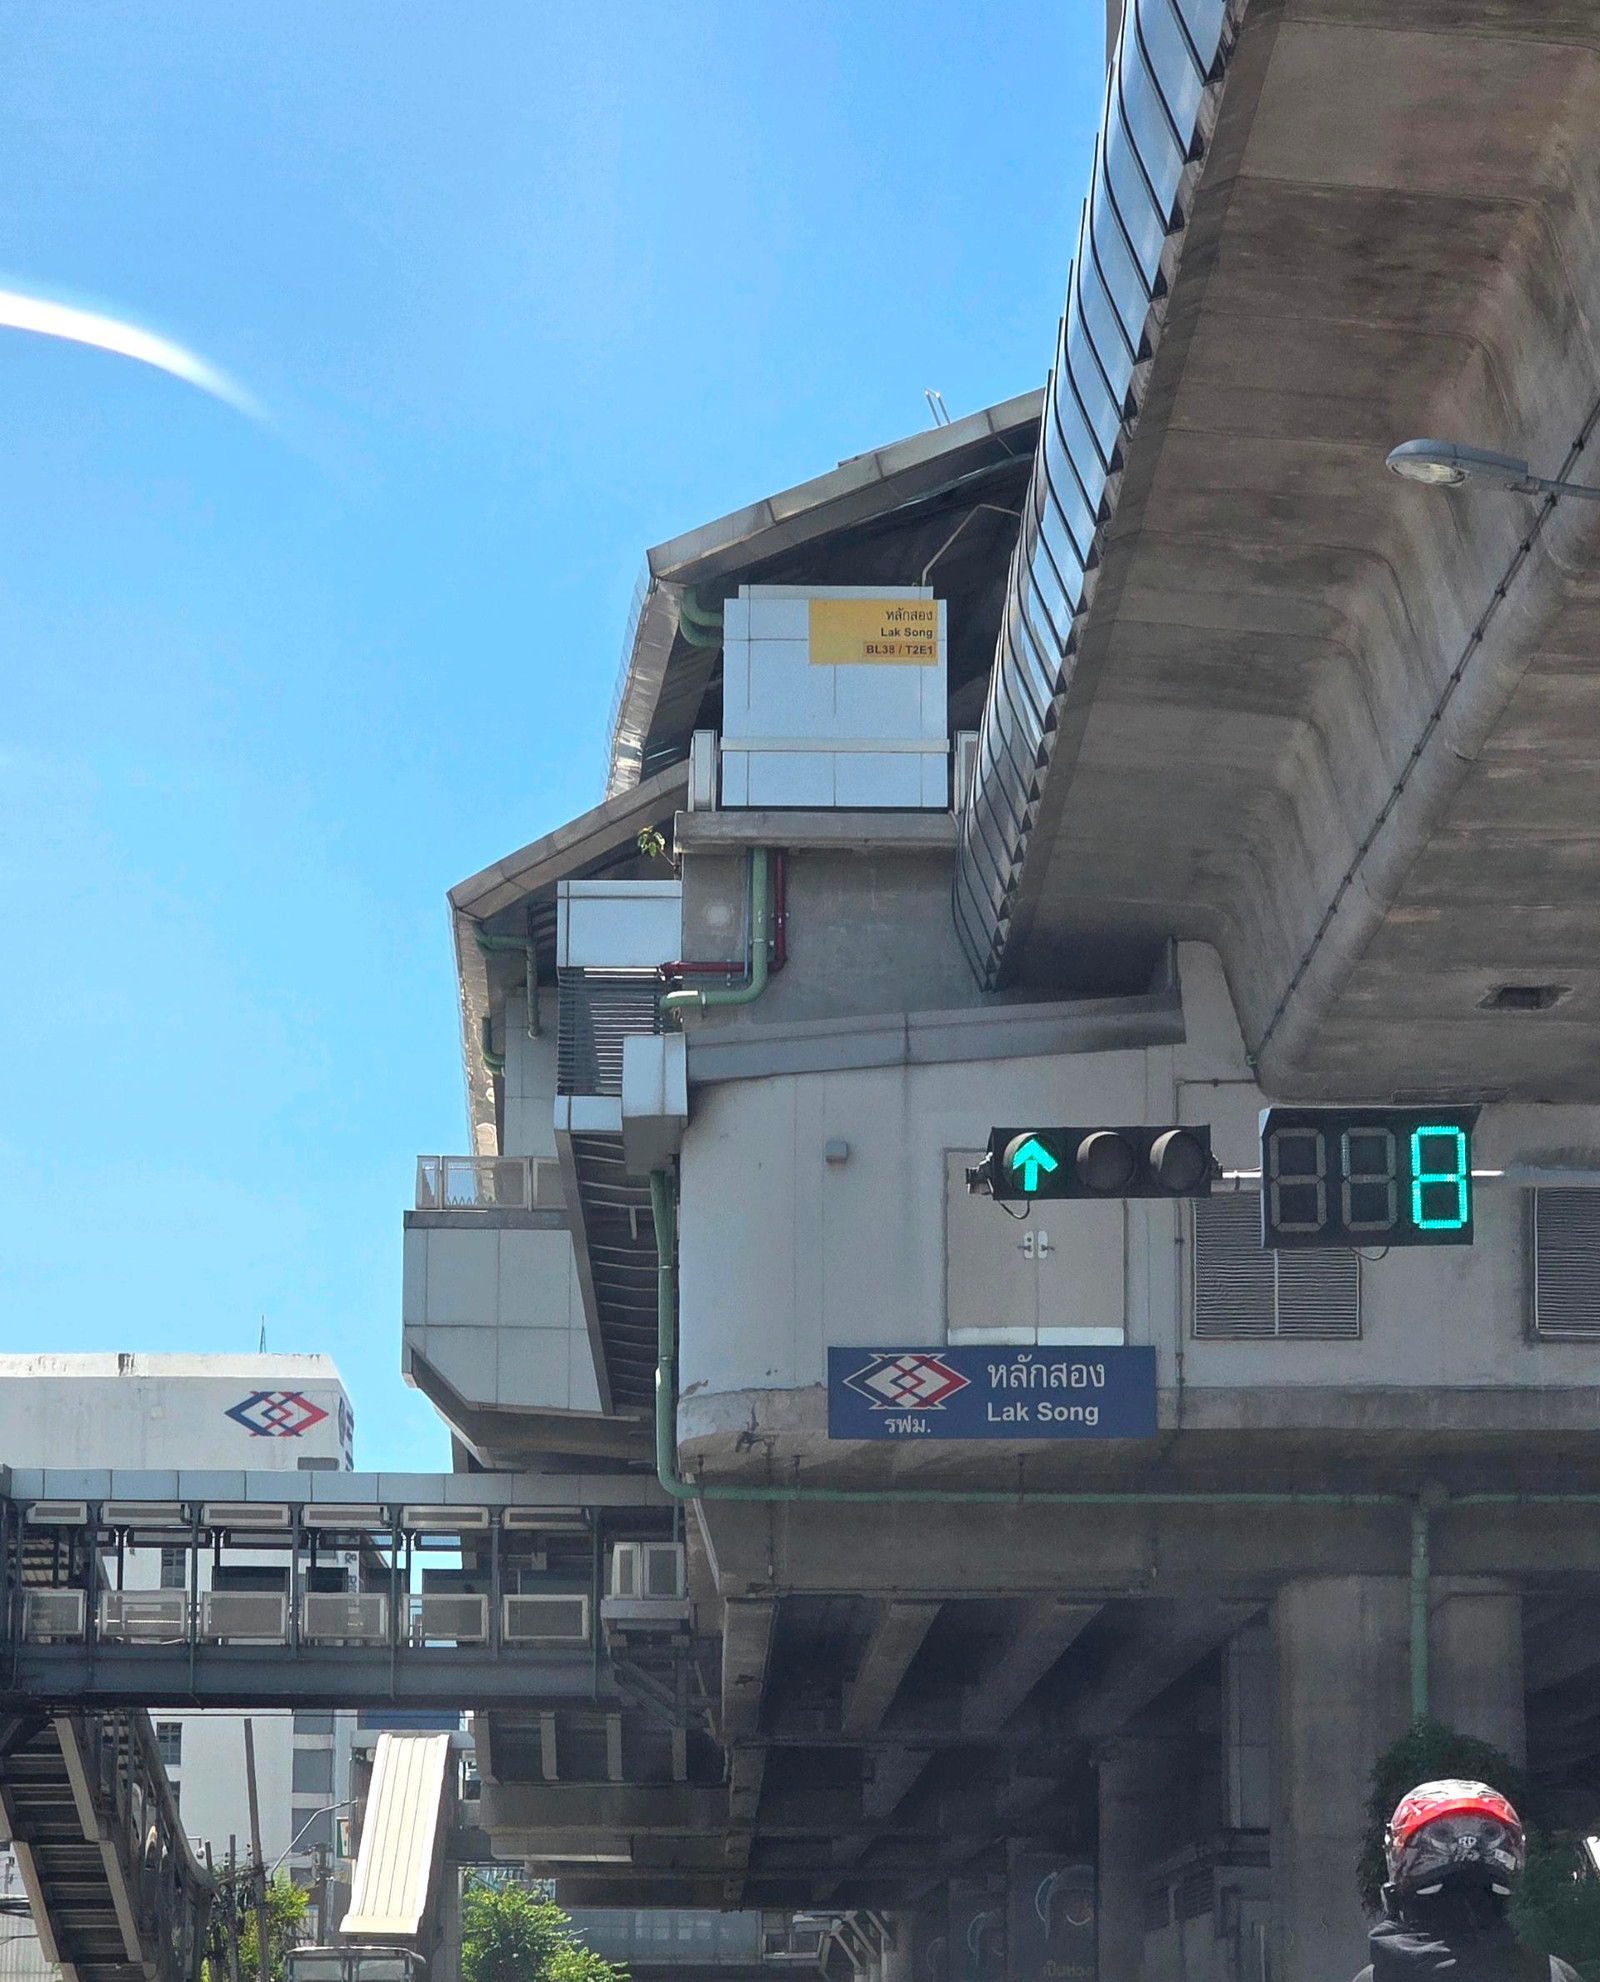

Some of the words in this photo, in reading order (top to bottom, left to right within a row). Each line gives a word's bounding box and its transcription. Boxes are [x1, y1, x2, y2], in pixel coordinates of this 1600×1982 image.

[886, 607, 933, 621] หลักสอง
[880, 627, 901, 637] Lak
[903, 627, 933, 639] Song
[866, 644, 895, 654] BL38
[905, 645, 933, 655] T2E1
[1411, 1126, 1467, 1229] 8
[987, 1353, 1105, 1388] หลักสอง
[987, 1402, 1029, 1422] Lak
[1037, 1401, 1099, 1425] Song
[884, 1414, 932, 1433] รฟม.
